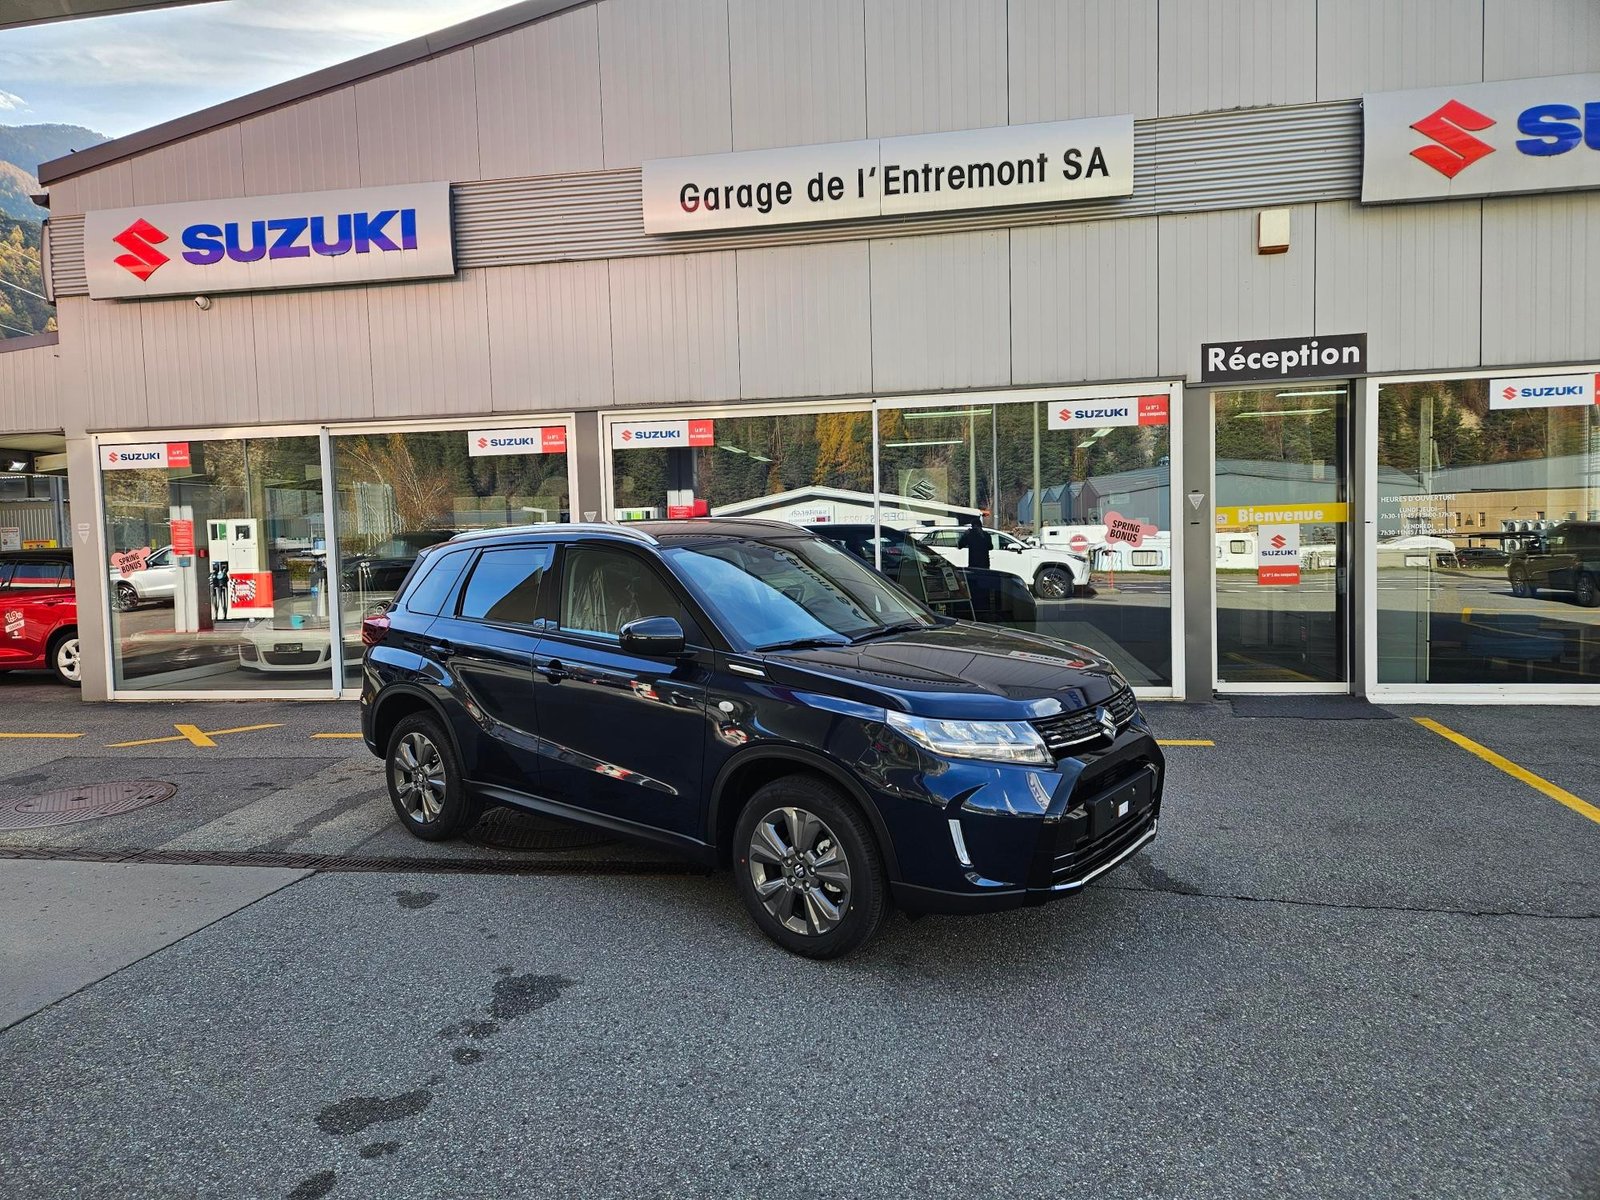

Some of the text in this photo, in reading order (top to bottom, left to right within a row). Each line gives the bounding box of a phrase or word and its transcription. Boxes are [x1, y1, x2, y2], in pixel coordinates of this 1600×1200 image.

[1516, 101, 1600, 157] S
[680, 180, 792, 214] Garage
[807, 172, 845, 202] de
[1062, 147, 1110, 181] SA
[181, 207, 418, 266] SUZUKI
[1208, 340, 1360, 374] Réception
[1521, 386, 1583, 397] SUZUKI
[1075, 408, 1128, 419] SUZUKI
[635, 430, 680, 439] SUZUKI
[490, 437, 534, 447] SUZUKI
[120, 452, 160, 461] SUZUKI
[1408, 494, 1457, 502] D'OUVERTURE
[1238, 507, 1324, 523] Bienvenue
[1111, 519, 1141, 534] SPRING
[1109, 528, 1138, 543] BONUS
[118, 552, 140, 566] SPRING
[121, 560, 142, 574] BONUS
